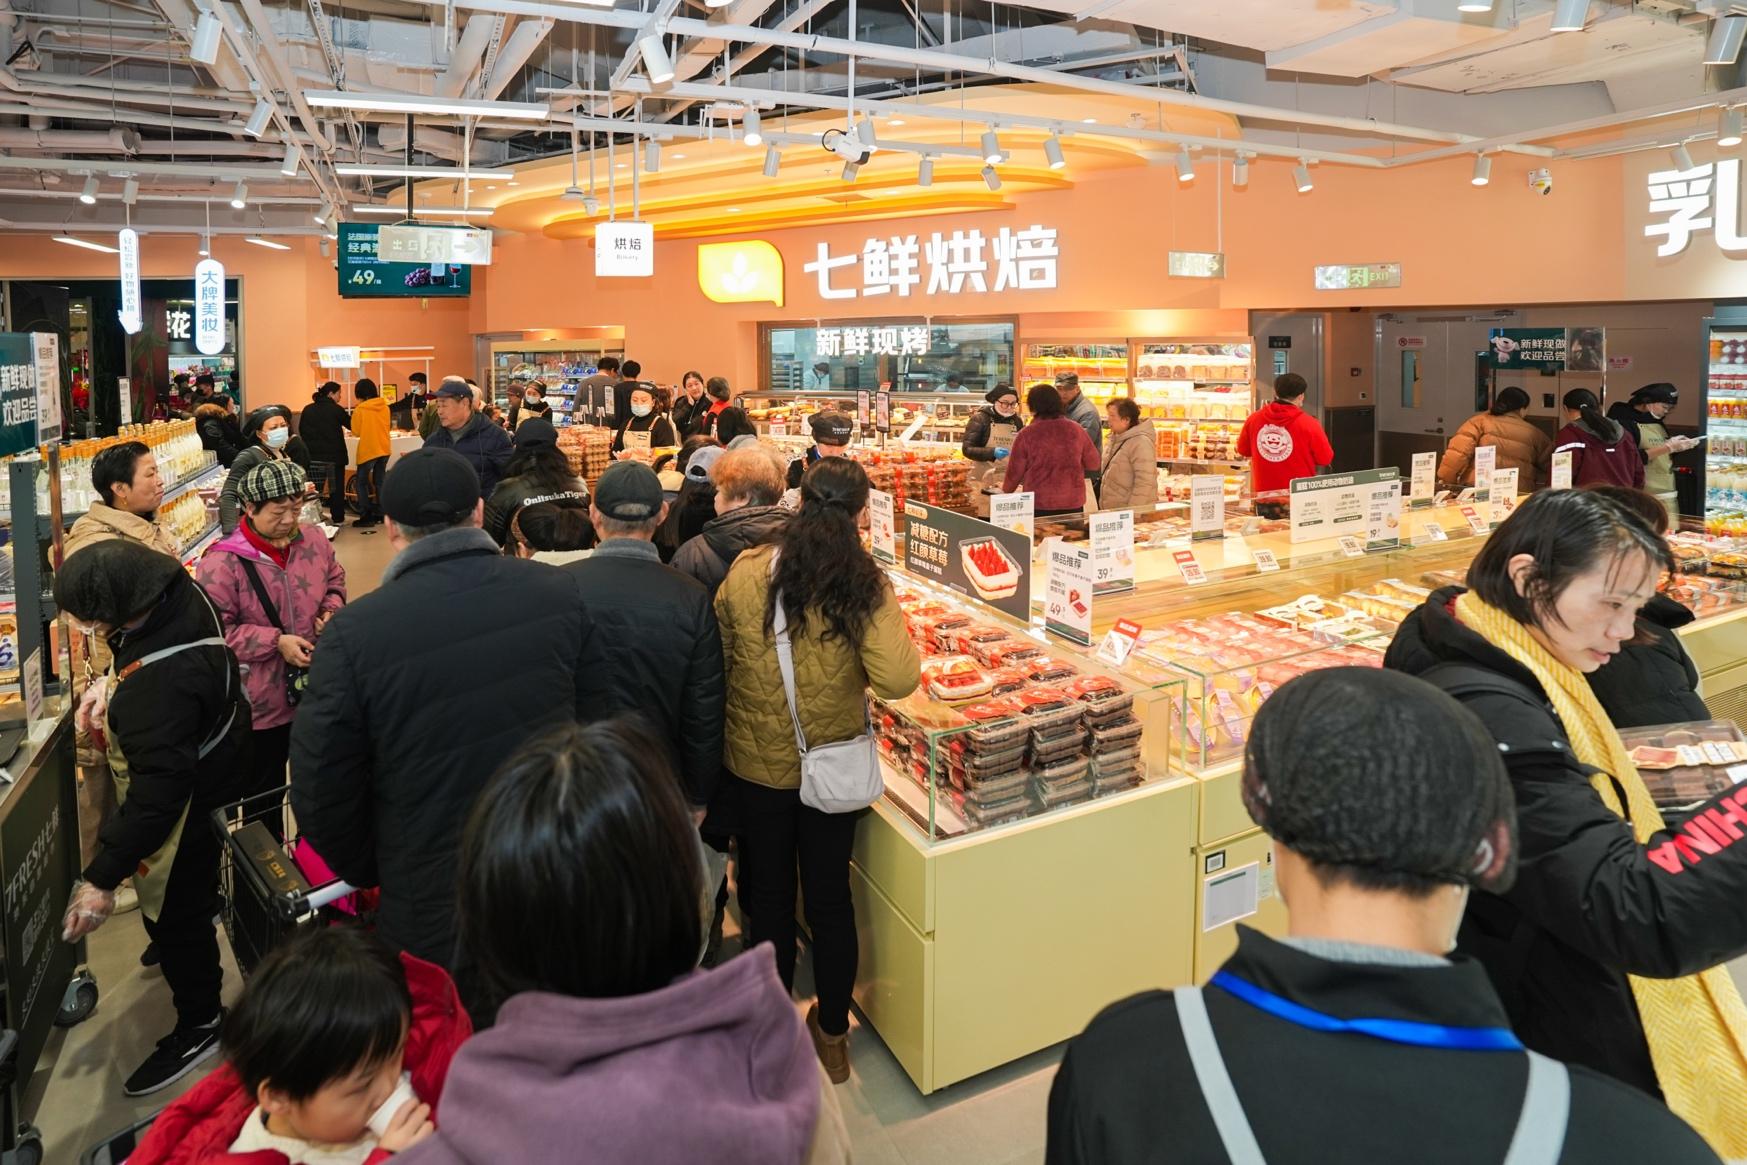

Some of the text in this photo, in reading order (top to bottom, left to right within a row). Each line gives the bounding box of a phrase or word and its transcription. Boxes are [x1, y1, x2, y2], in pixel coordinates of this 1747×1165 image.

[1645, 159, 1747, 256] 乳
[615, 237, 642, 250] 烘焙
[804, 225, 1059, 299] 七鲜烘焙
[1370, 272, 1390, 281] EXIT
[201, 271, 219, 332] 大牌美妆
[816, 326, 928, 356] 新鲜现烤
[1520, 338, 1566, 349] 新鲜现做
[1520, 351, 1566, 361] 欢迎品尝
[2, 396, 38, 426] 欢迎品尝
[910, 521, 949, 548] 减糖配方
[910, 539, 949, 567] 红颜草莓
[1052, 551, 1082, 569] 爆品推荐
[1097, 568, 1109, 579] 39
[1050, 602, 1061, 616] 49
